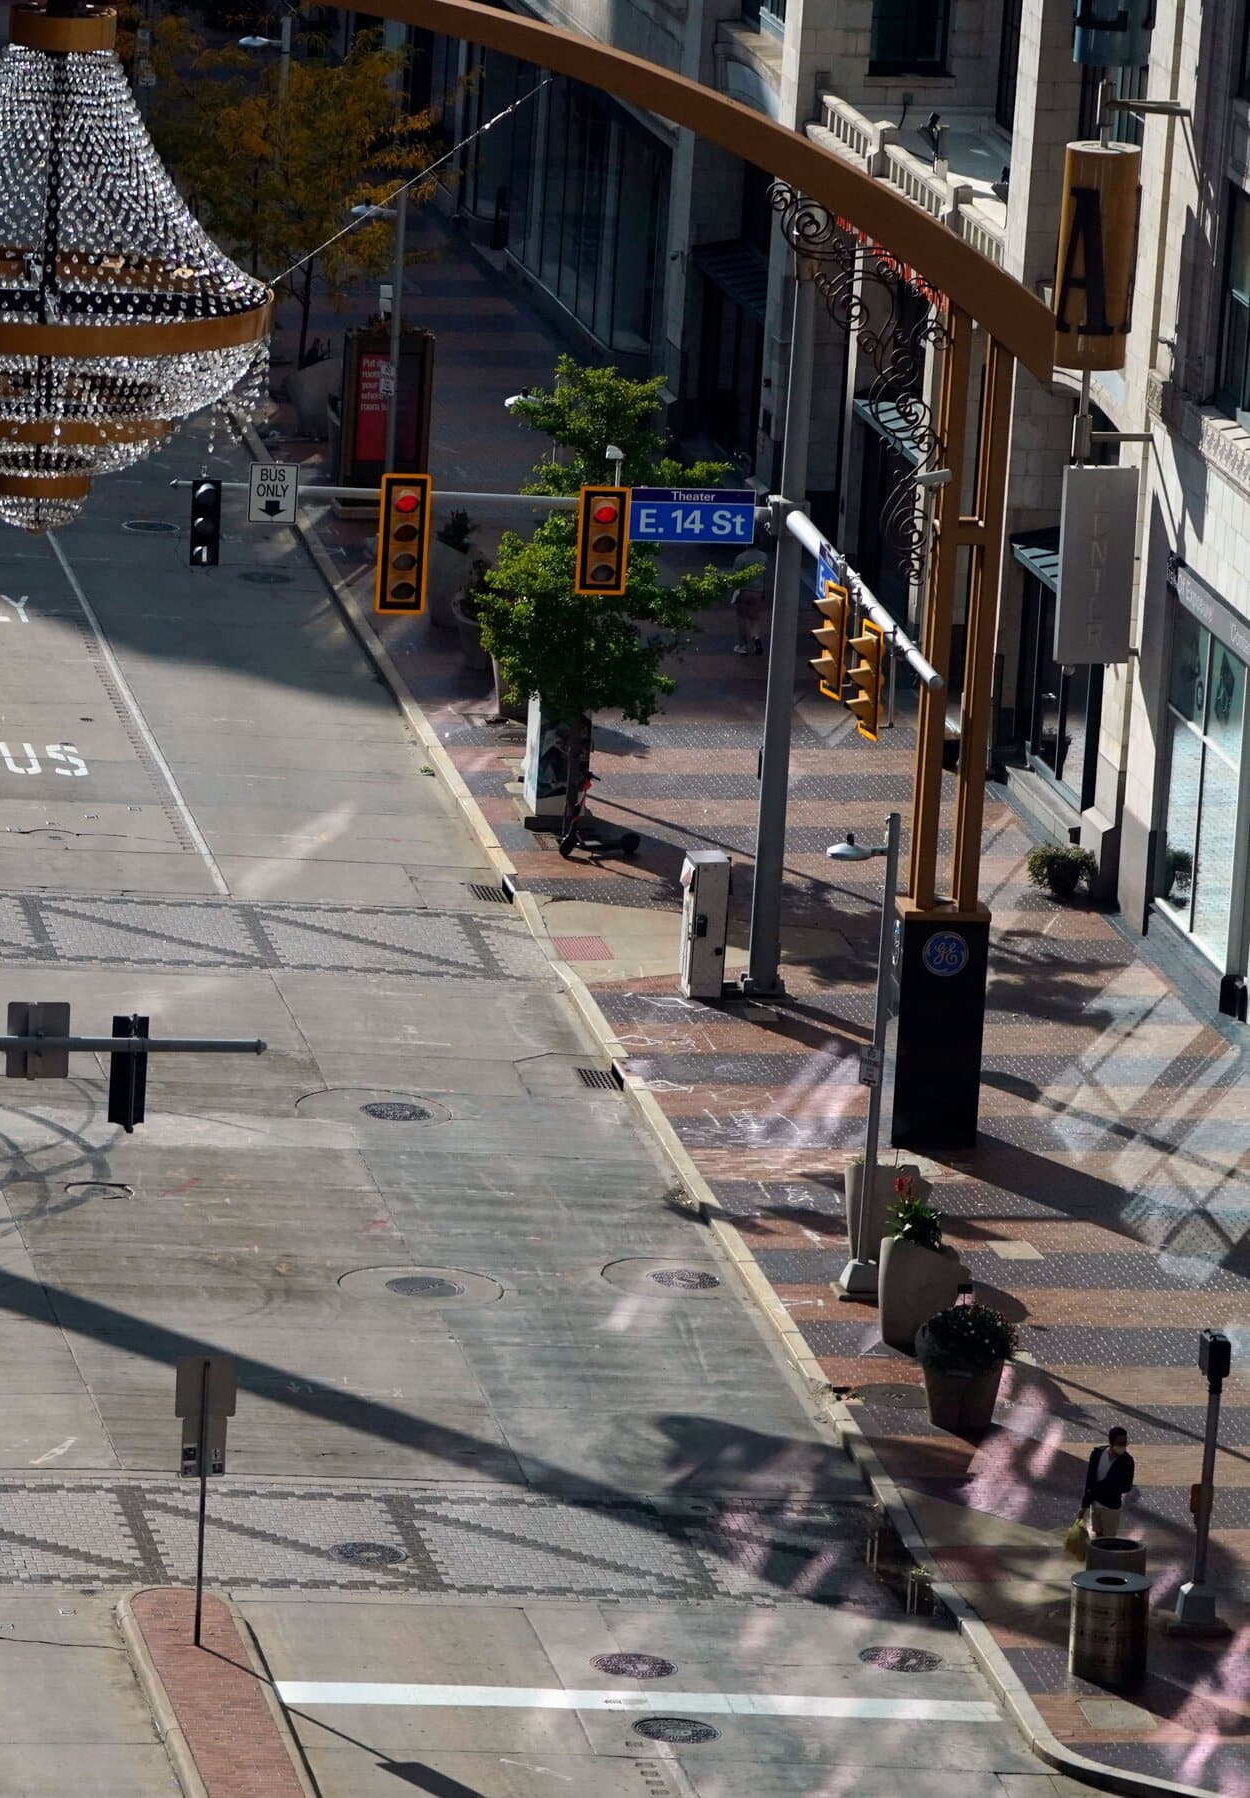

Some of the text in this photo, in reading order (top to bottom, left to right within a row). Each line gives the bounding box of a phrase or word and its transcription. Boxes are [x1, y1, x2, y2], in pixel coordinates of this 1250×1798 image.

[260, 468, 287, 482] BUS
[256, 483, 290, 498] ONLY
[671, 490, 716, 502] Theater
[639, 508, 745, 536] E. 14 St
